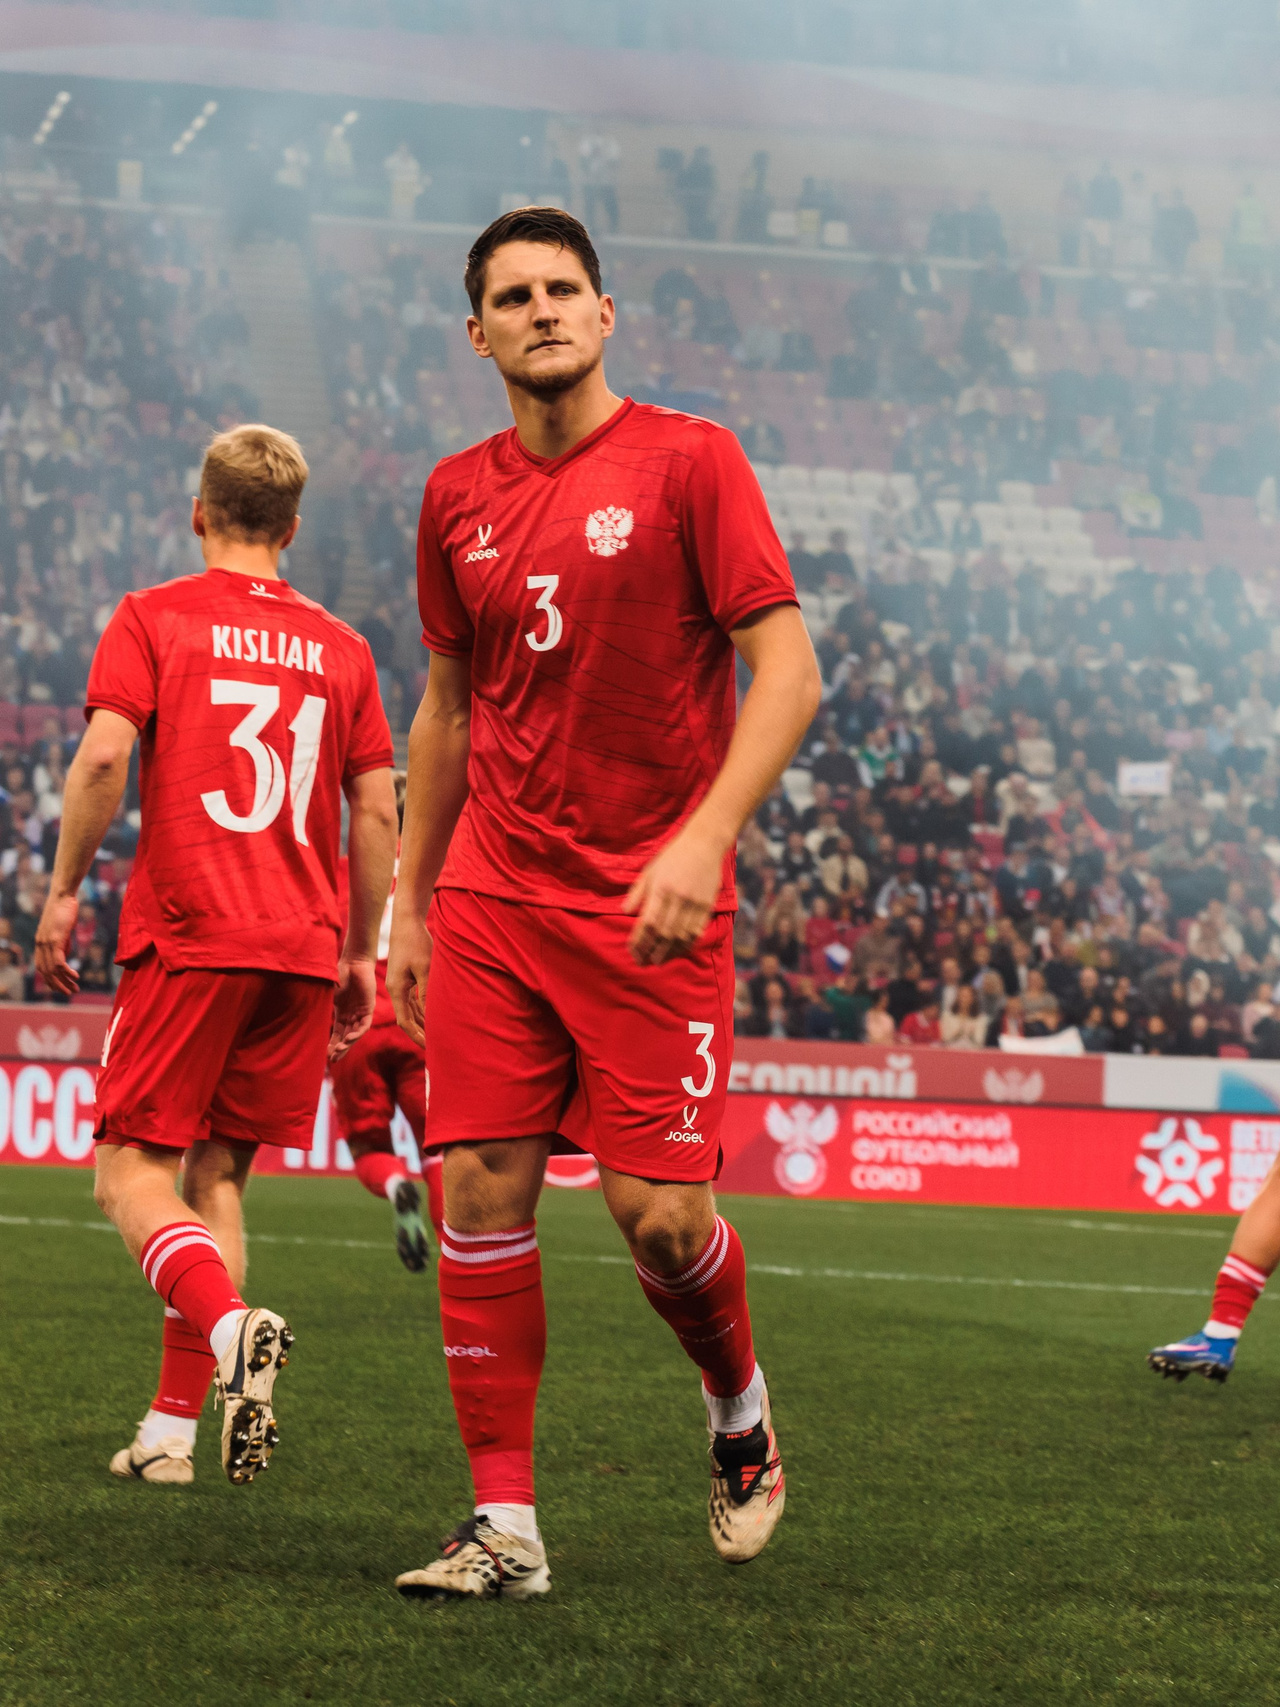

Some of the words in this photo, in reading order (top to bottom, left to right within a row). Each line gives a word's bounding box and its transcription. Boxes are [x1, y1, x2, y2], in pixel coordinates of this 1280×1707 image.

[212, 625, 325, 676] KISLIAK
[525, 574, 563, 652] 3
[200, 678, 327, 847] 31
[680, 1020, 717, 1098] 3
